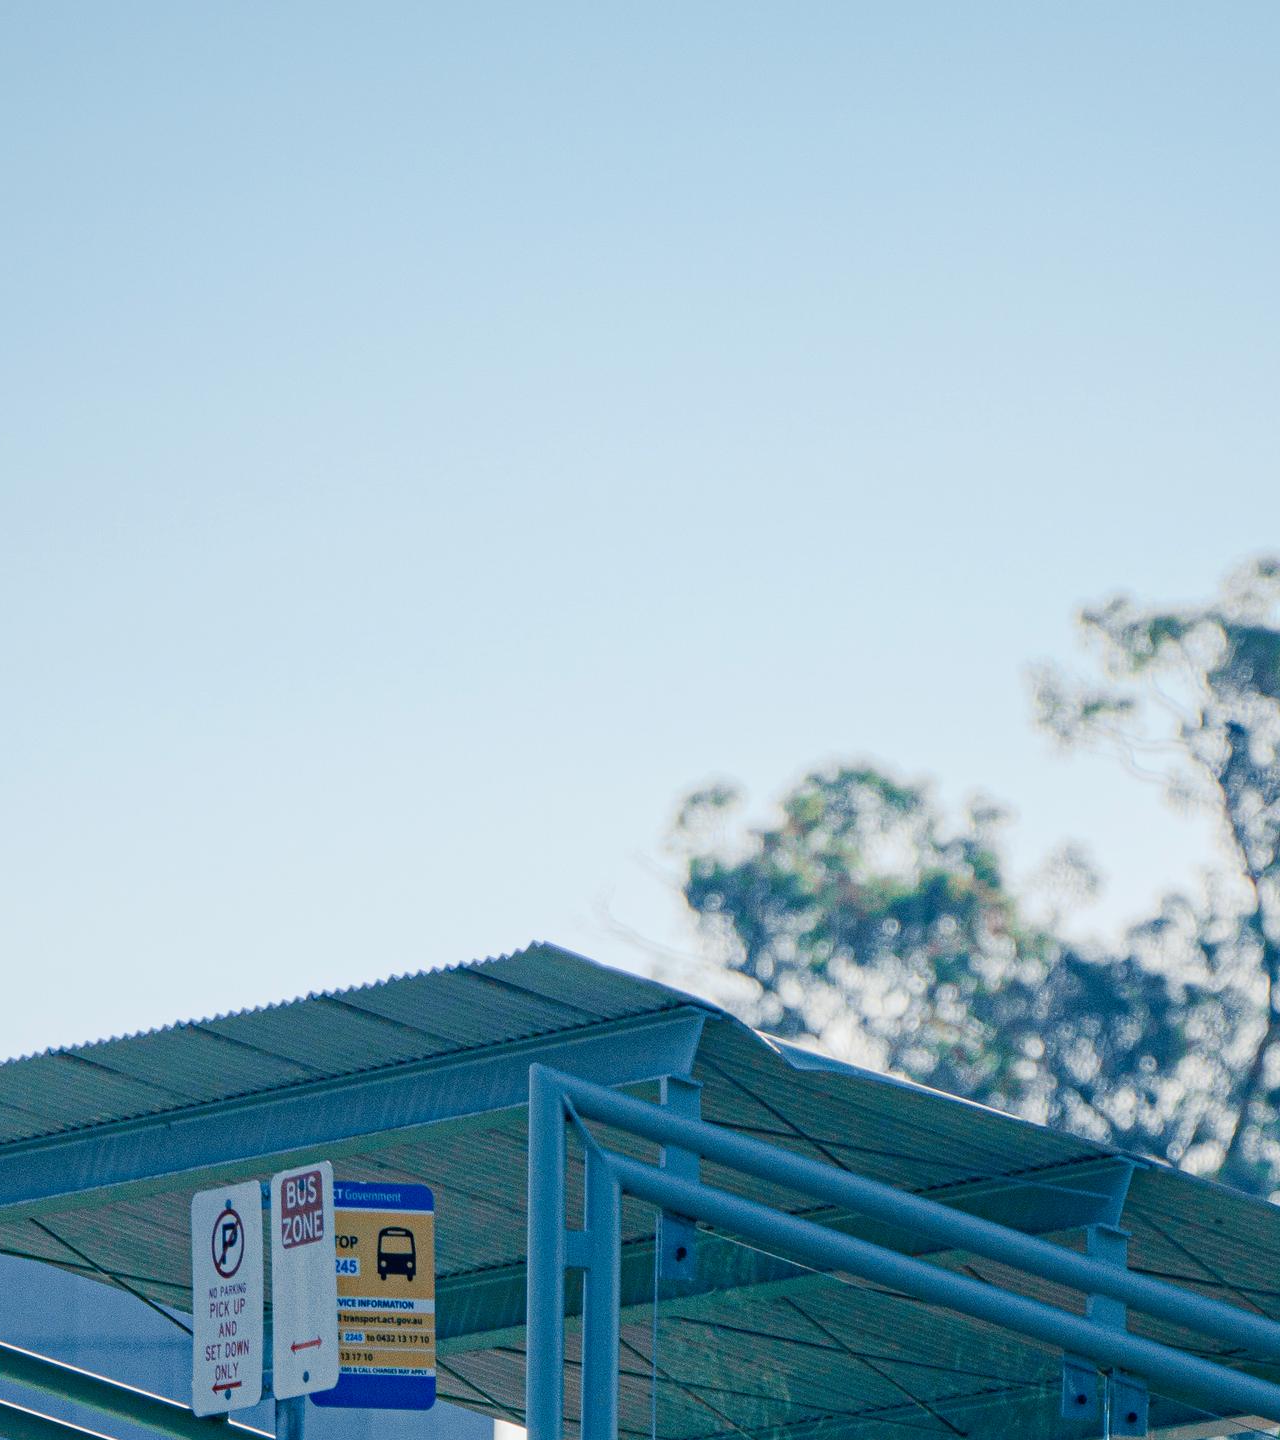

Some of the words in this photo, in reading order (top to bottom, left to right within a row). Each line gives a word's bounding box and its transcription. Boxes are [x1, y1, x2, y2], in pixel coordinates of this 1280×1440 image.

[286, 1176, 317, 1209] BUS
[333, 1189, 343, 1199] CT
[345, 1189, 401, 1201] Government
[282, 1210, 323, 1245] ZONE
[335, 1234, 358, 1248] TOP
[336, 1259, 357, 1273] 245
[209, 1287, 218, 1298] NO
[220, 1282, 247, 1297] PARKING
[210, 1301, 230, 1319] PICK
[233, 1298, 246, 1315] UP
[337, 1298, 356, 1307] VICE
[358, 1299, 413, 1309] INFORMATION
[344, 1316, 423, 1326] transport.act.gov.au
[219, 1320, 237, 1338] AND
[345, 1333, 363, 1341] 2245
[366, 1333, 375, 1341] to
[376, 1334, 395, 1342] 0432
[398, 1335, 407, 1343] 13
[409, 1335, 418, 1343] 17
[420, 1335, 429, 1343] 10
[205, 1344, 222, 1361] SET
[225, 1340, 250, 1358] DOWN
[340, 1352, 350, 1360] 13
[363, 1353, 373, 1361] 10
[215, 1362, 239, 1380] ONLY
